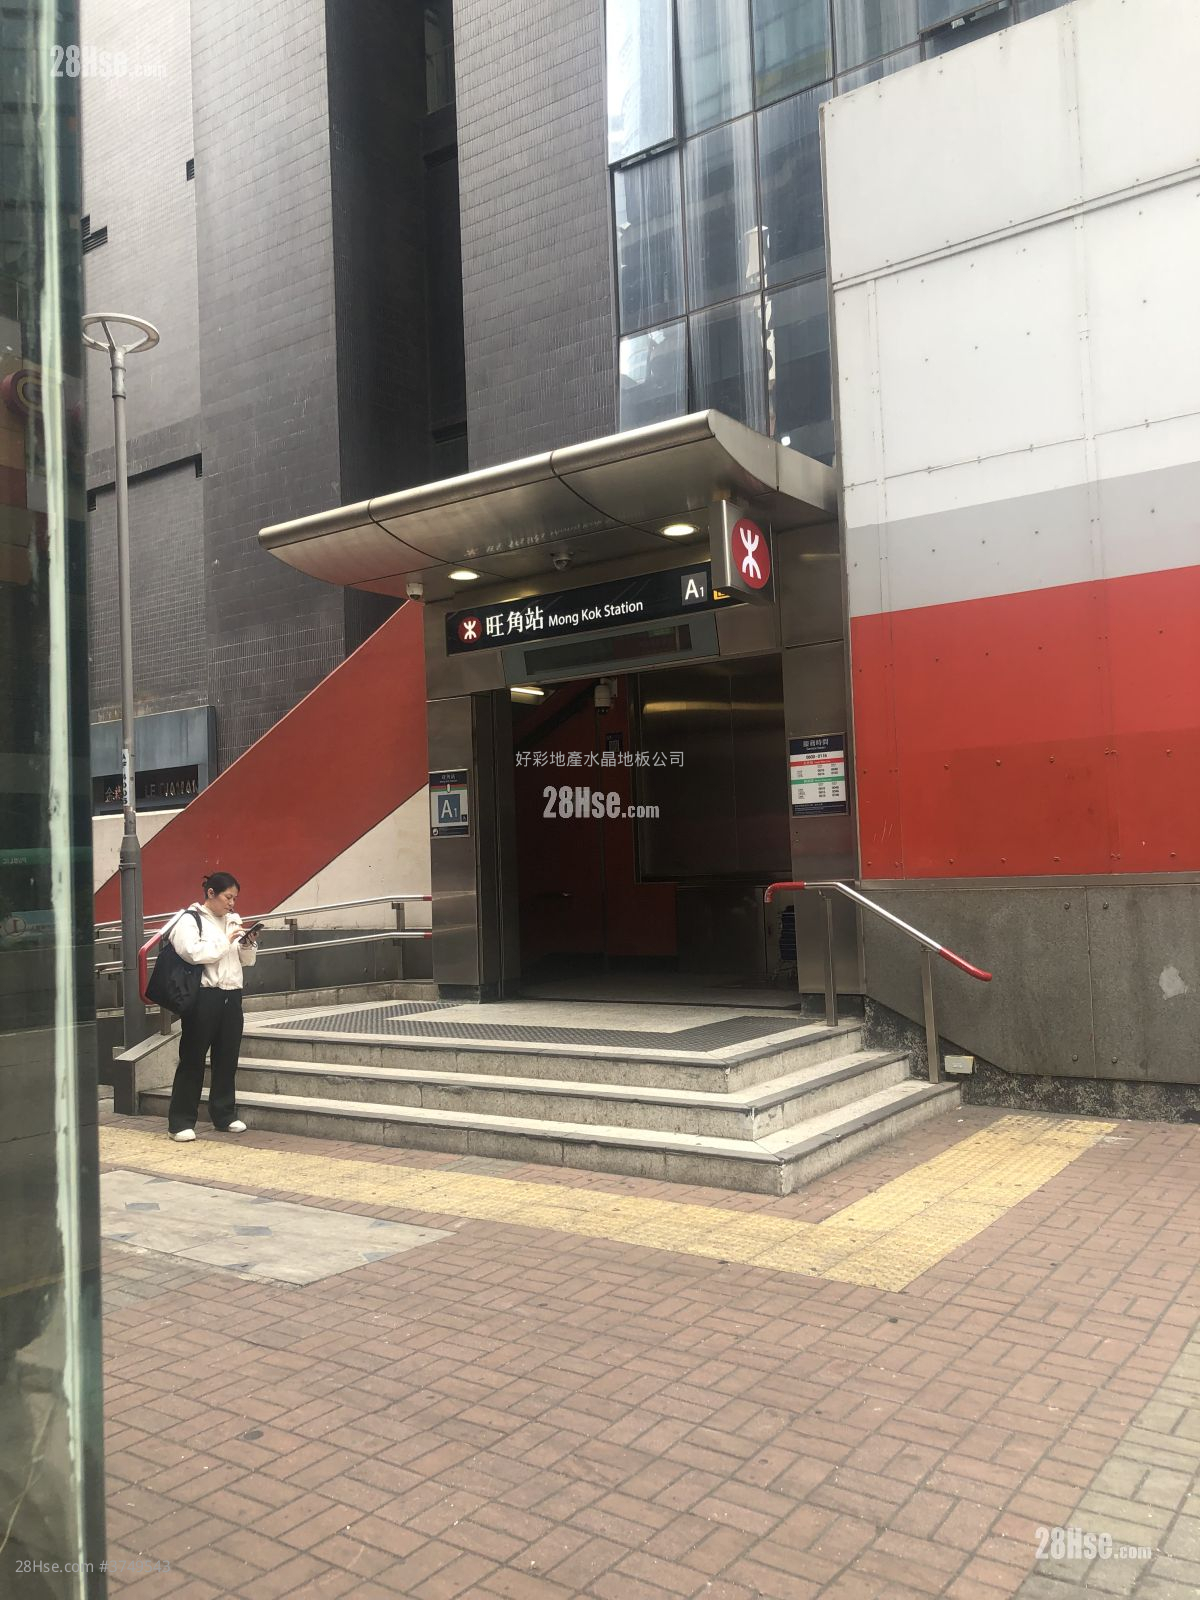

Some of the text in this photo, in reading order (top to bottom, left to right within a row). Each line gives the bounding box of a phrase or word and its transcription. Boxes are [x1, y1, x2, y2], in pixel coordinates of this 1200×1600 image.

[684, 578, 704, 600] A1
[485, 606, 544, 638] 旺角站
[548, 602, 643, 628] Mong Kok Station
[441, 799, 458, 819] A1
